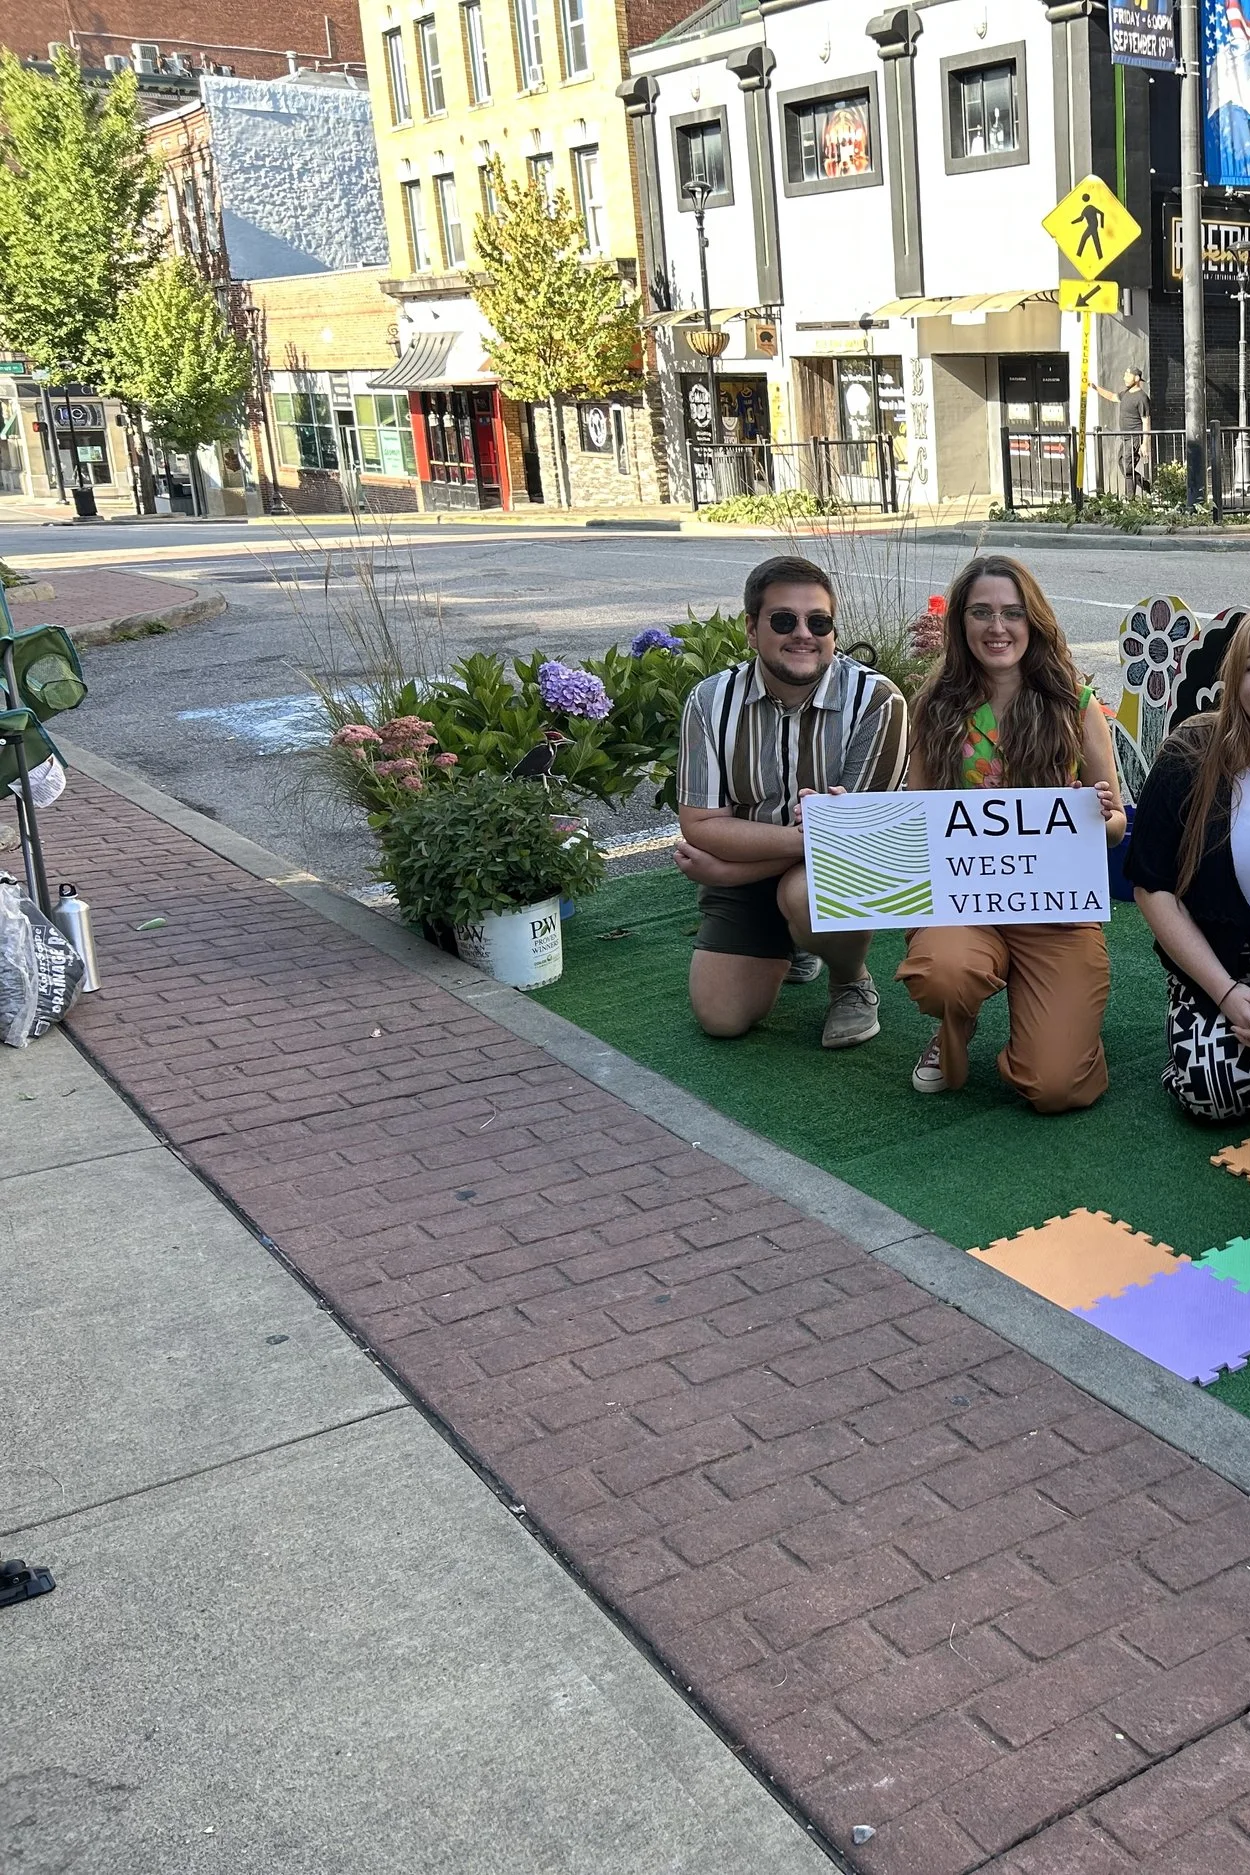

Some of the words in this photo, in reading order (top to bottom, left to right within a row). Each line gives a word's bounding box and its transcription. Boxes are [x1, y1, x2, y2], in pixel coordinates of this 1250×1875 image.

[1113, 8, 1140, 27] FRIDAY
[1113, 29, 1157, 56] SEPTEMBER
[1081, 371, 1088, 384] TO
[944, 797, 1078, 838] ASLA
[945, 854, 1038, 877] WEST
[948, 890, 1104, 914] VIRGINIA
[529, 912, 558, 940] PW
[534, 933, 558, 947] PROVEN
[51, 947, 67, 1013] DRAINAGE
